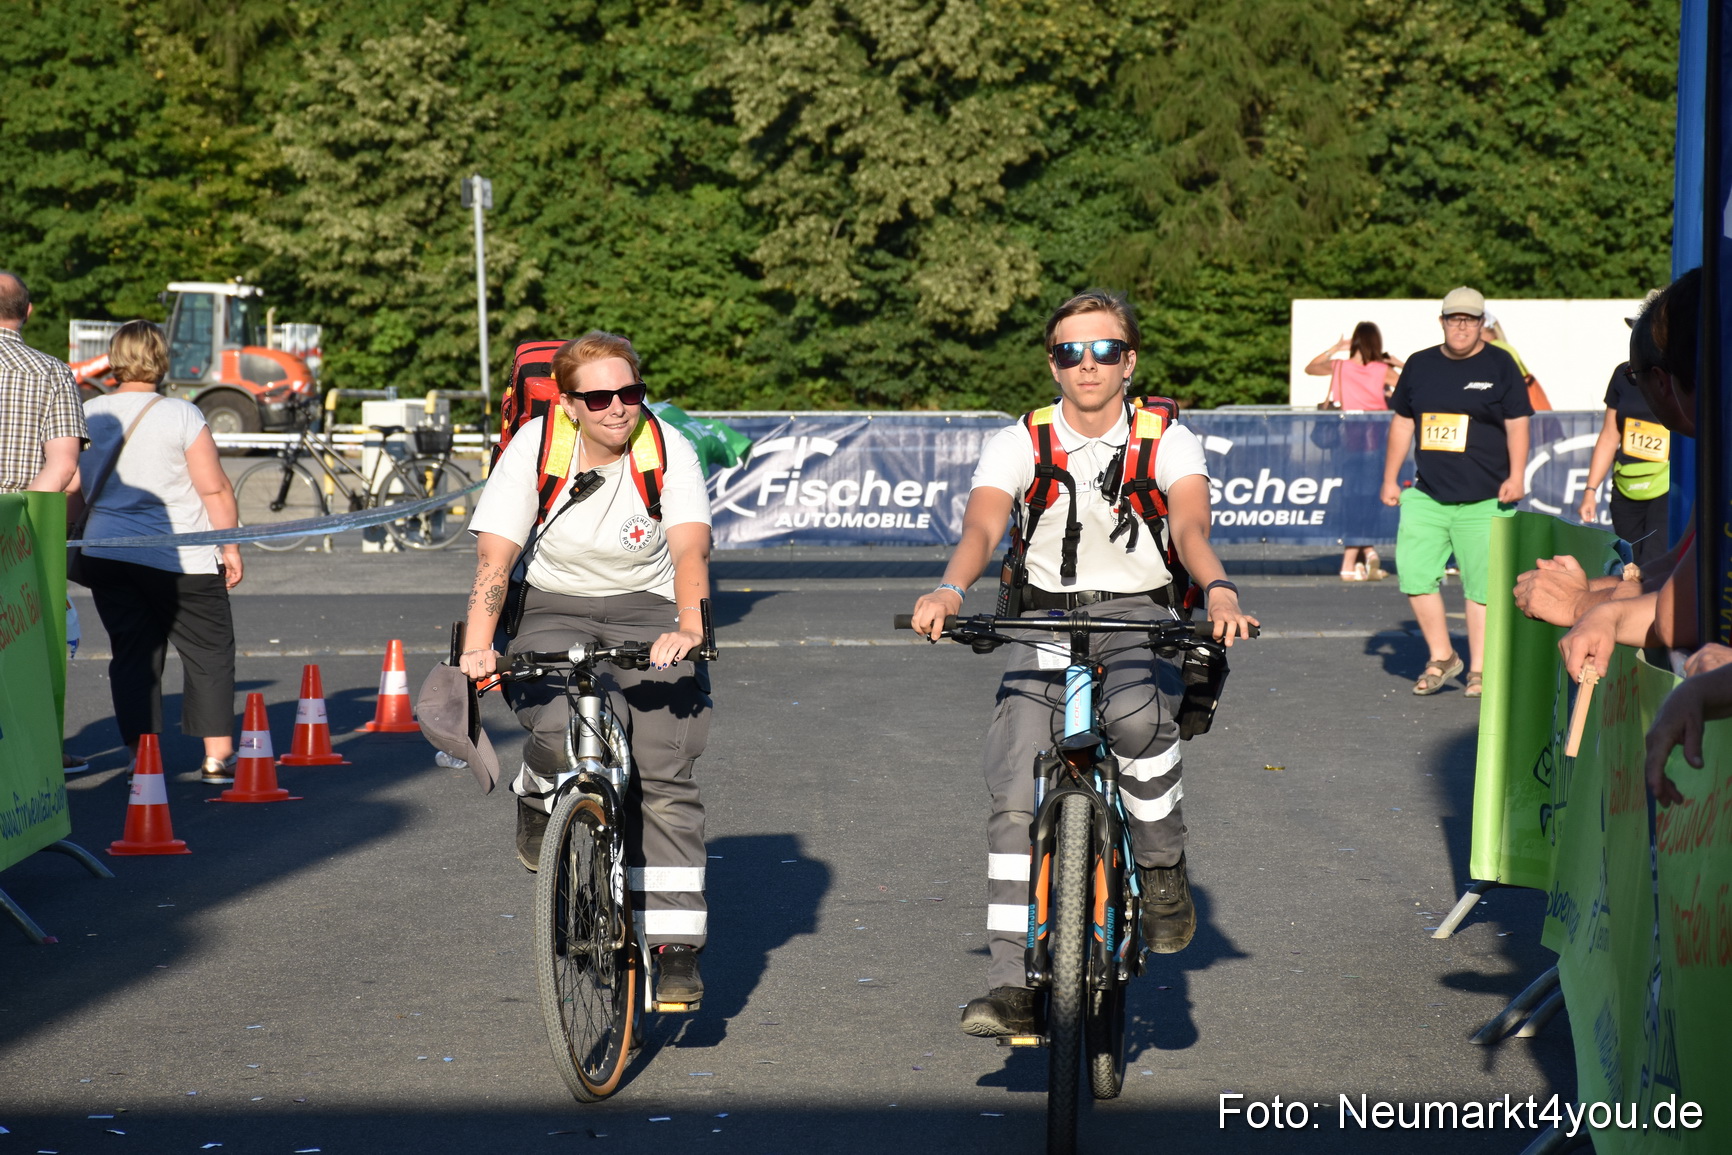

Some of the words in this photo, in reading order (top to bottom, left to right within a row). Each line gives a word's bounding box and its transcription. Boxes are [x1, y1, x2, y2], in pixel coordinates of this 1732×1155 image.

[1427, 427, 1457, 440] 1121
[1630, 432, 1663, 451] 1122
[757, 469, 949, 508] Fischer
[1210, 468, 1343, 505] scher
[774, 512, 931, 529] AUTOMOBILE
[1210, 510, 1326, 526] TOMOBILE
